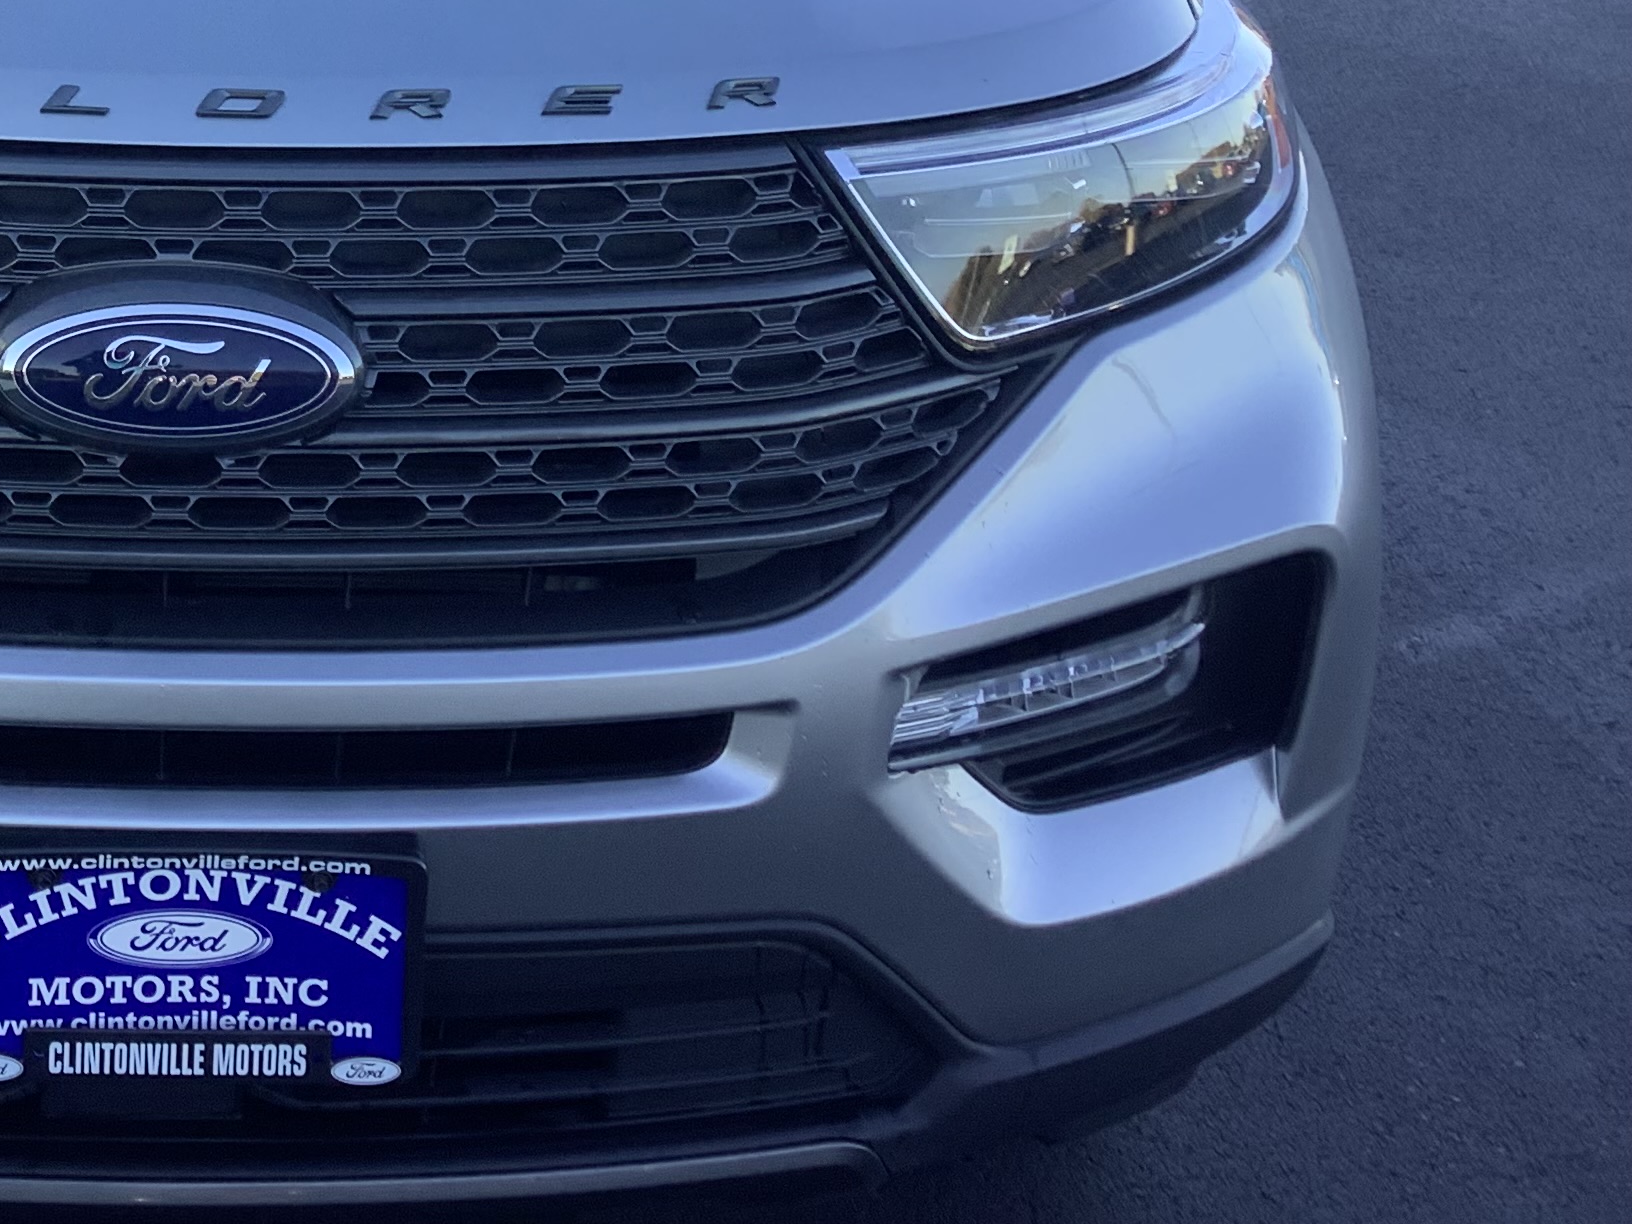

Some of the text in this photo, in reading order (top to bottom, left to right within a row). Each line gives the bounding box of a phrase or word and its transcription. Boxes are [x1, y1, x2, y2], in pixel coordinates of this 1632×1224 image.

[83, 334, 272, 412] Ford
[129, 919, 228, 955] Ford
[28, 974, 329, 1010] MOTORS, INC
[48, 1040, 308, 1078] CLINTONVILLE MOTORS
[344, 1062, 387, 1082] Ford
